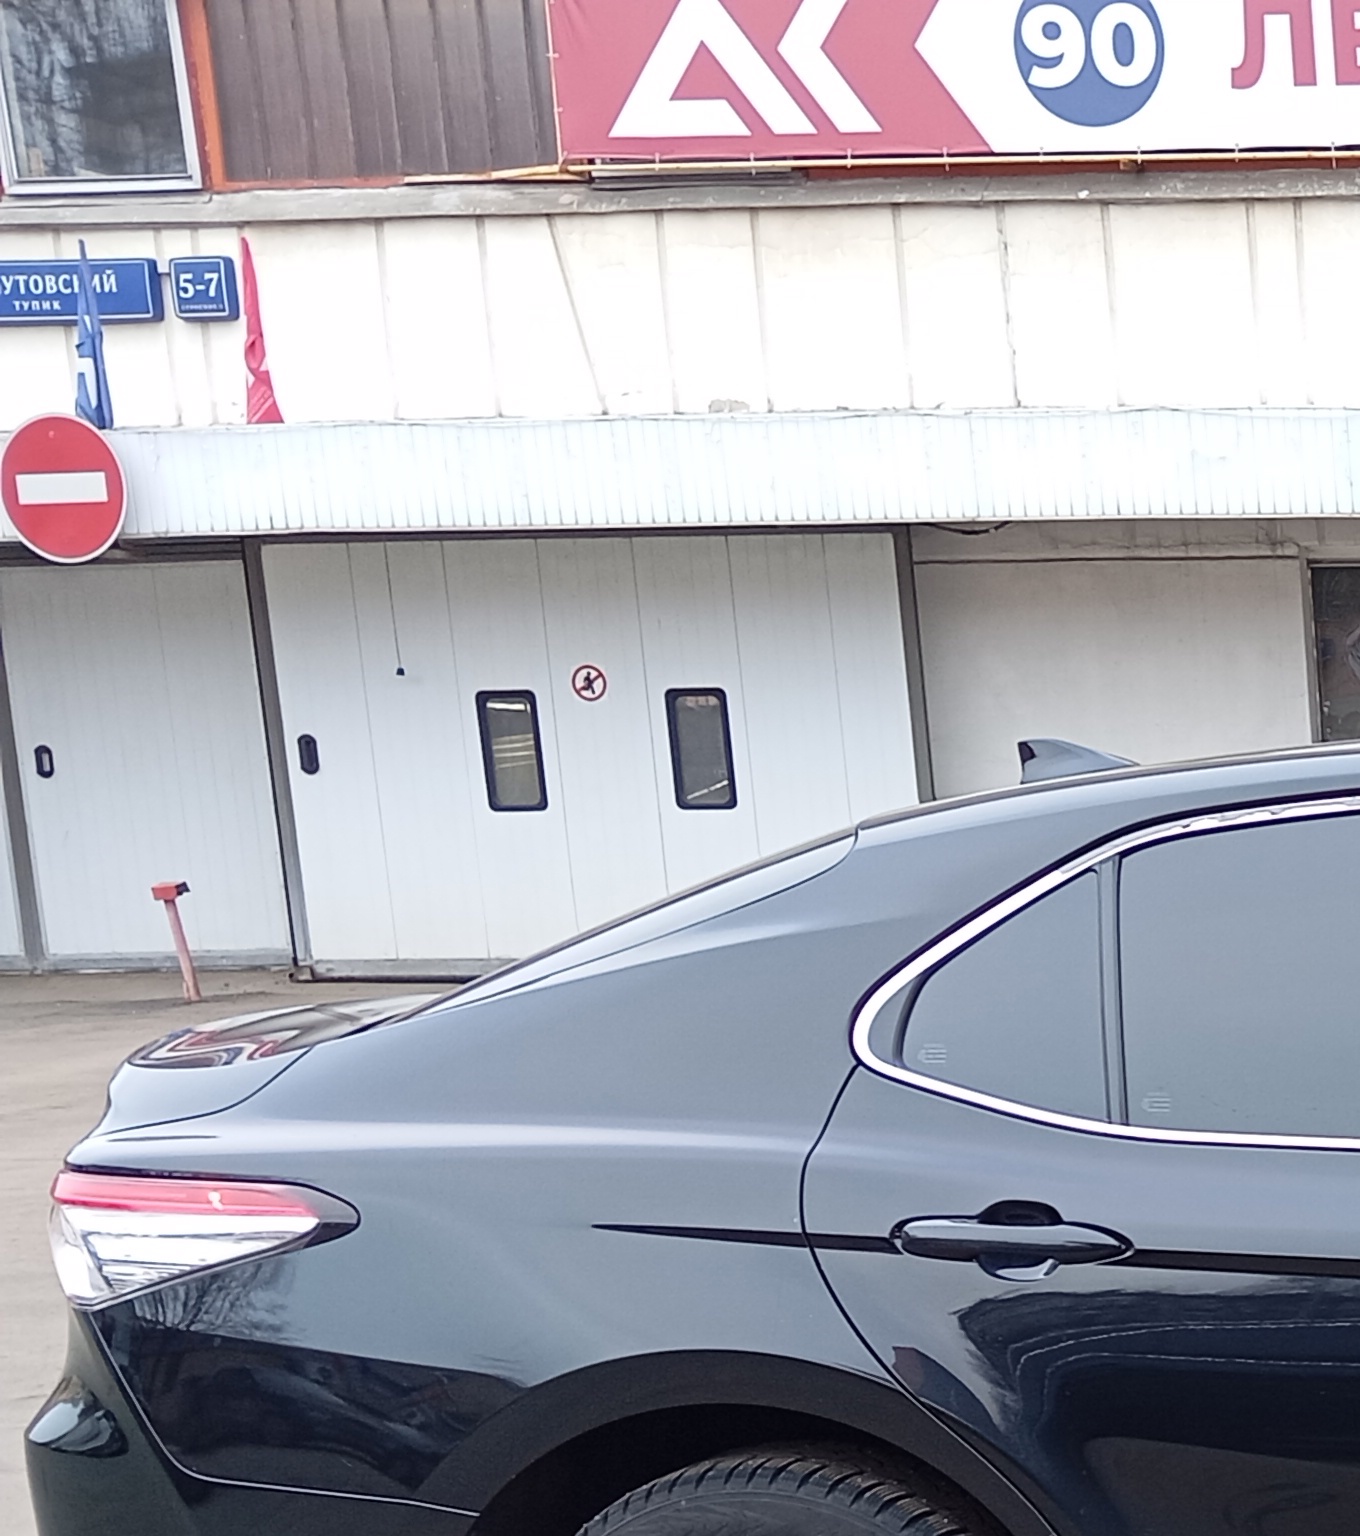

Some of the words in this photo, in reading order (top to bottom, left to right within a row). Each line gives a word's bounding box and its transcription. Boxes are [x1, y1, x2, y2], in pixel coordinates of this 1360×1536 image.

[1020, 2, 1157, 90] 90
[0, 269, 118, 296] УТОВСИЙ
[178, 272, 219, 299] 5-7
[12, 300, 61, 312] ТУПИК
